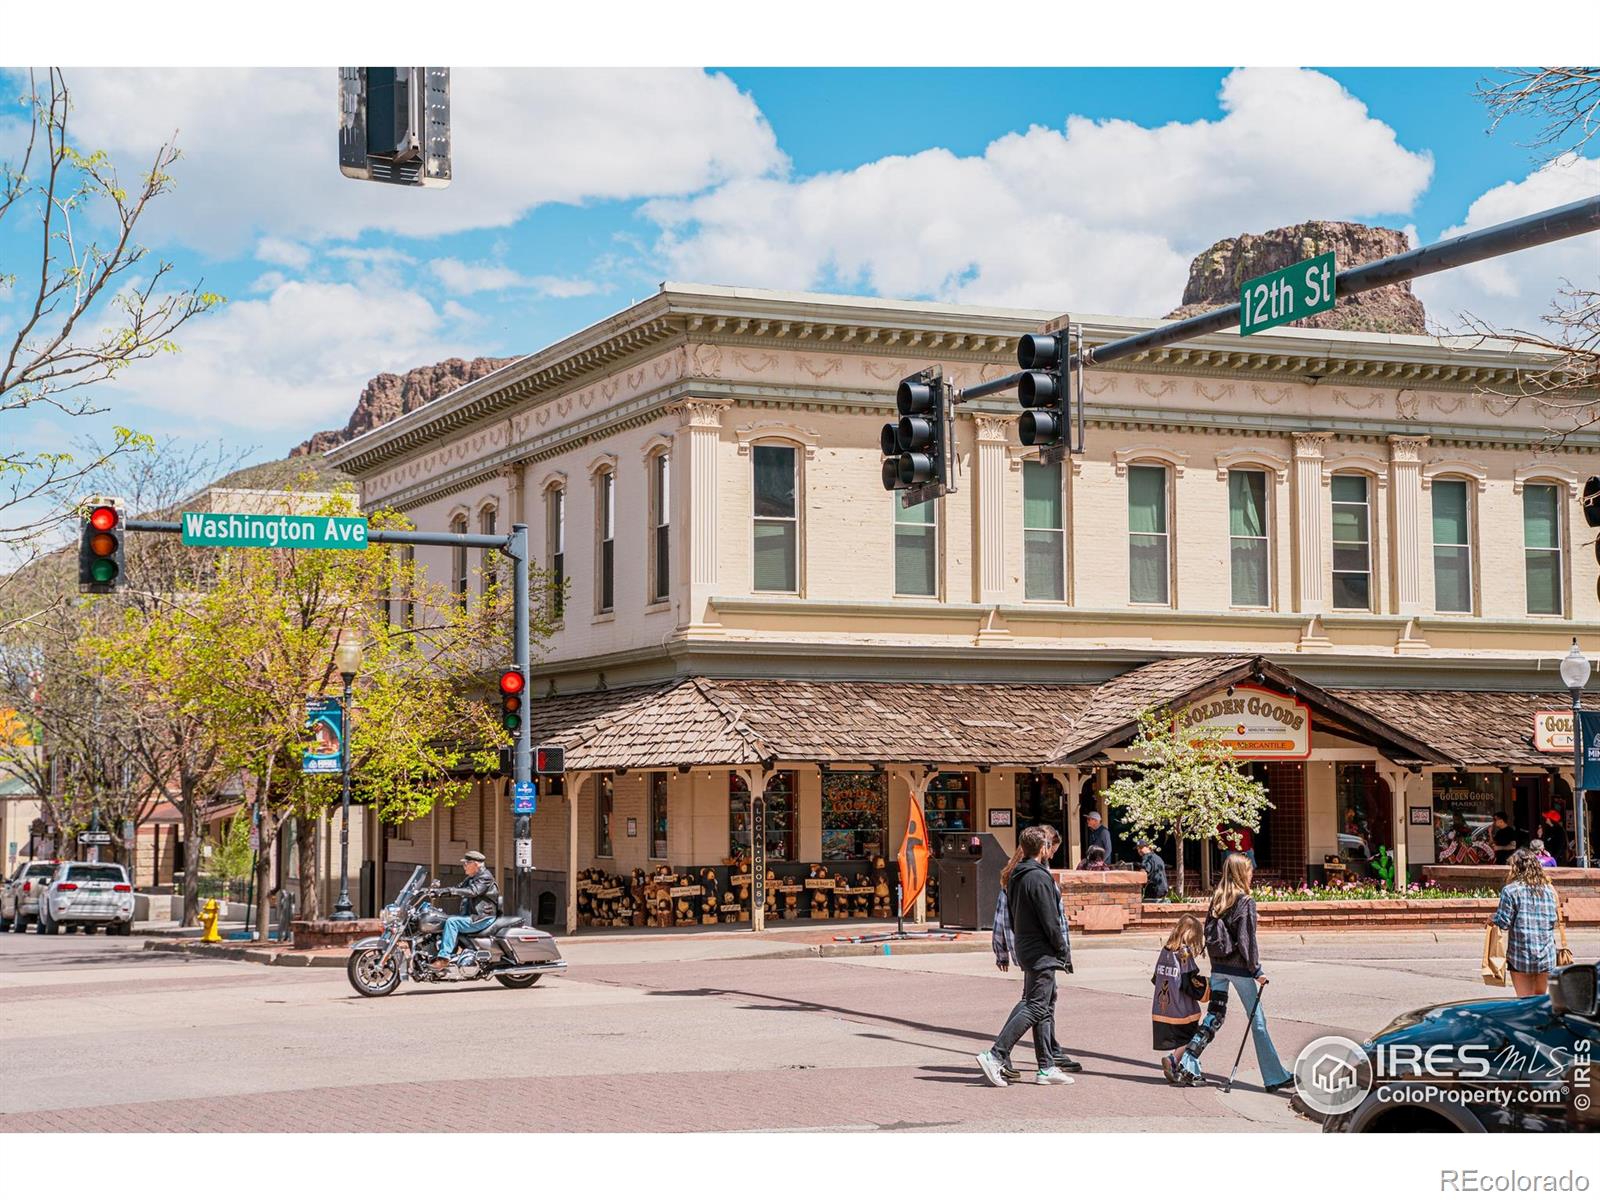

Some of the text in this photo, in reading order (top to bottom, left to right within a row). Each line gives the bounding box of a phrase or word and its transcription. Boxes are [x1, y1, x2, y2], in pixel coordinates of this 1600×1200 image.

[1244, 262, 1331, 328] 12th St
[186, 513, 366, 547] Washington Ave
[1247, 696, 1304, 731] GOODS
[1545, 715, 1574, 732] GOL
[1439, 791, 1495, 801] GOLDEN GOODS
[755, 856, 763, 898] GOODS
